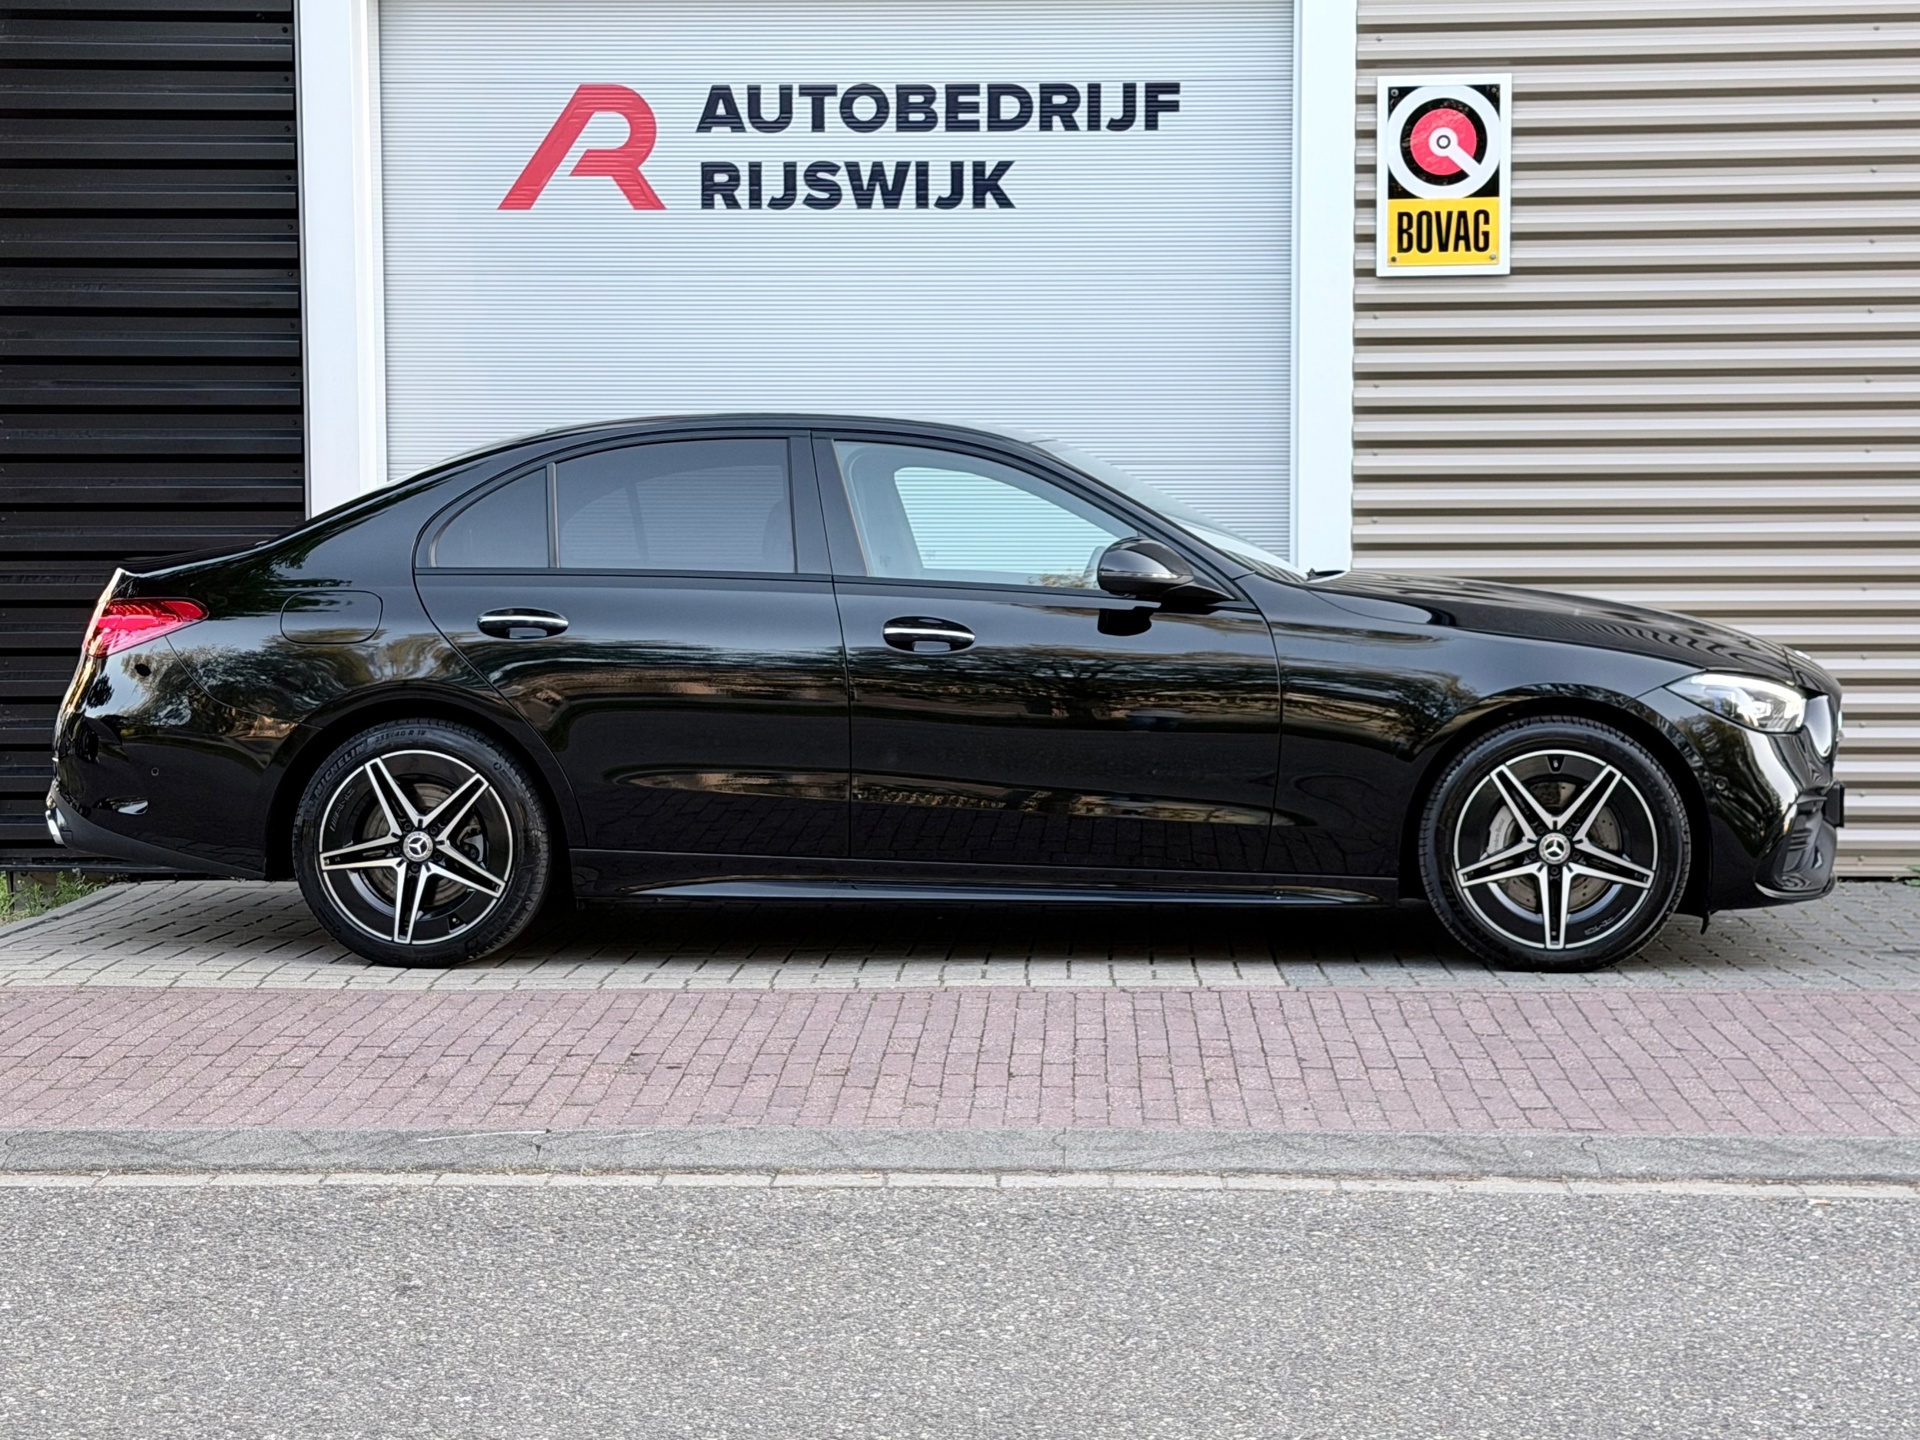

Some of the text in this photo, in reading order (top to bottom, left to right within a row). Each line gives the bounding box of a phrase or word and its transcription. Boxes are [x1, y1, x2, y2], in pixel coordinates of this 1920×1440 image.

[697, 83, 1180, 133] AUTOBEDRIJF
[701, 161, 1014, 209] RIJSWIJK
[1397, 209, 1490, 253] BOVAG
[313, 742, 367, 798] MICHELIN
